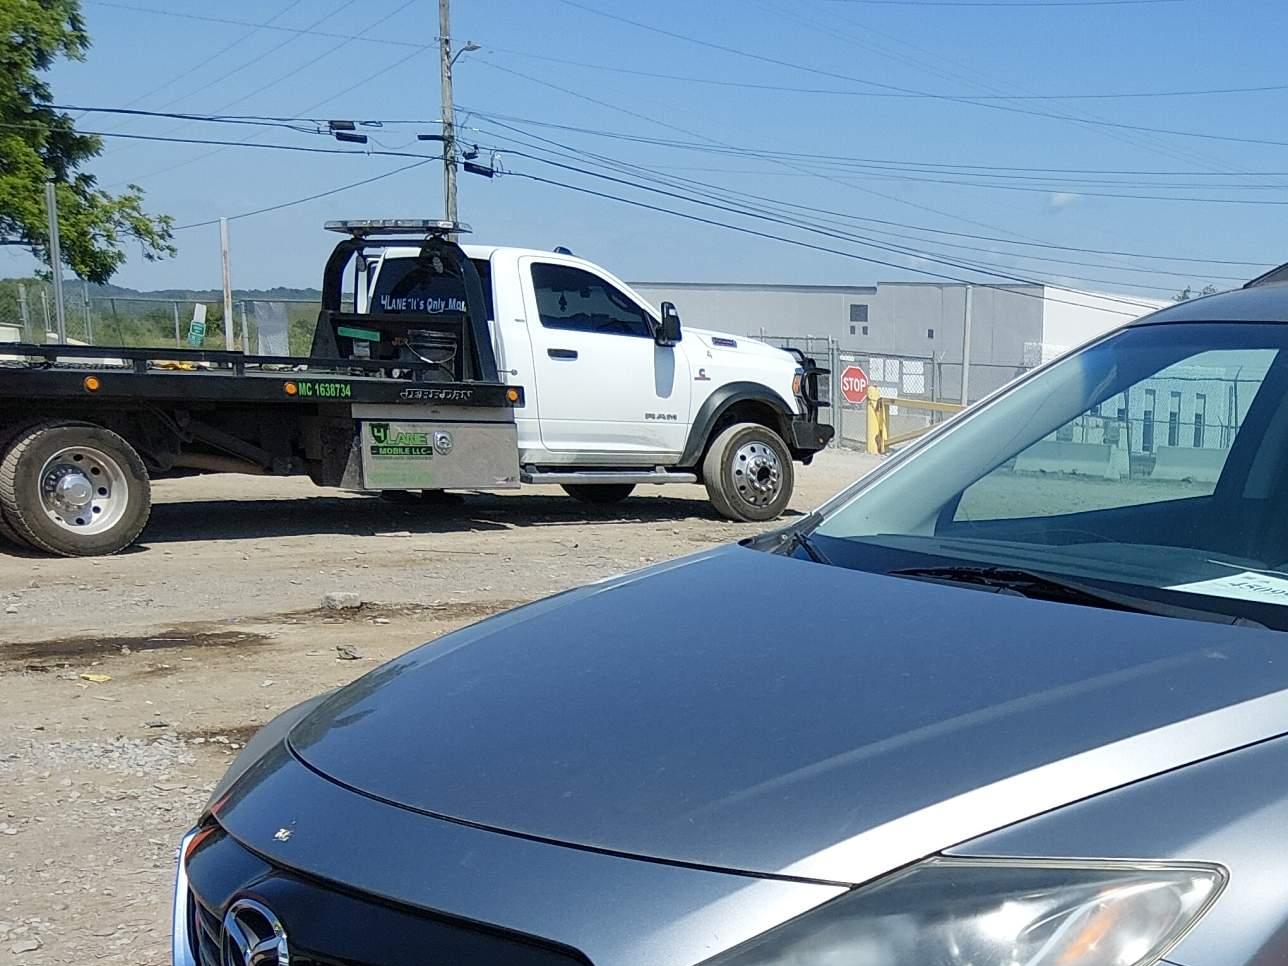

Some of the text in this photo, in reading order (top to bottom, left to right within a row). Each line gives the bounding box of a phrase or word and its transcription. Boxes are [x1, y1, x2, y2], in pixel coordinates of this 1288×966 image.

[427, 298, 446, 314] Only
[298, 382, 352, 398] MC 1638734
[842, 377, 867, 393] STOP
[645, 413, 678, 421] RAM
[379, 447, 427, 456] MOBILE LLC
